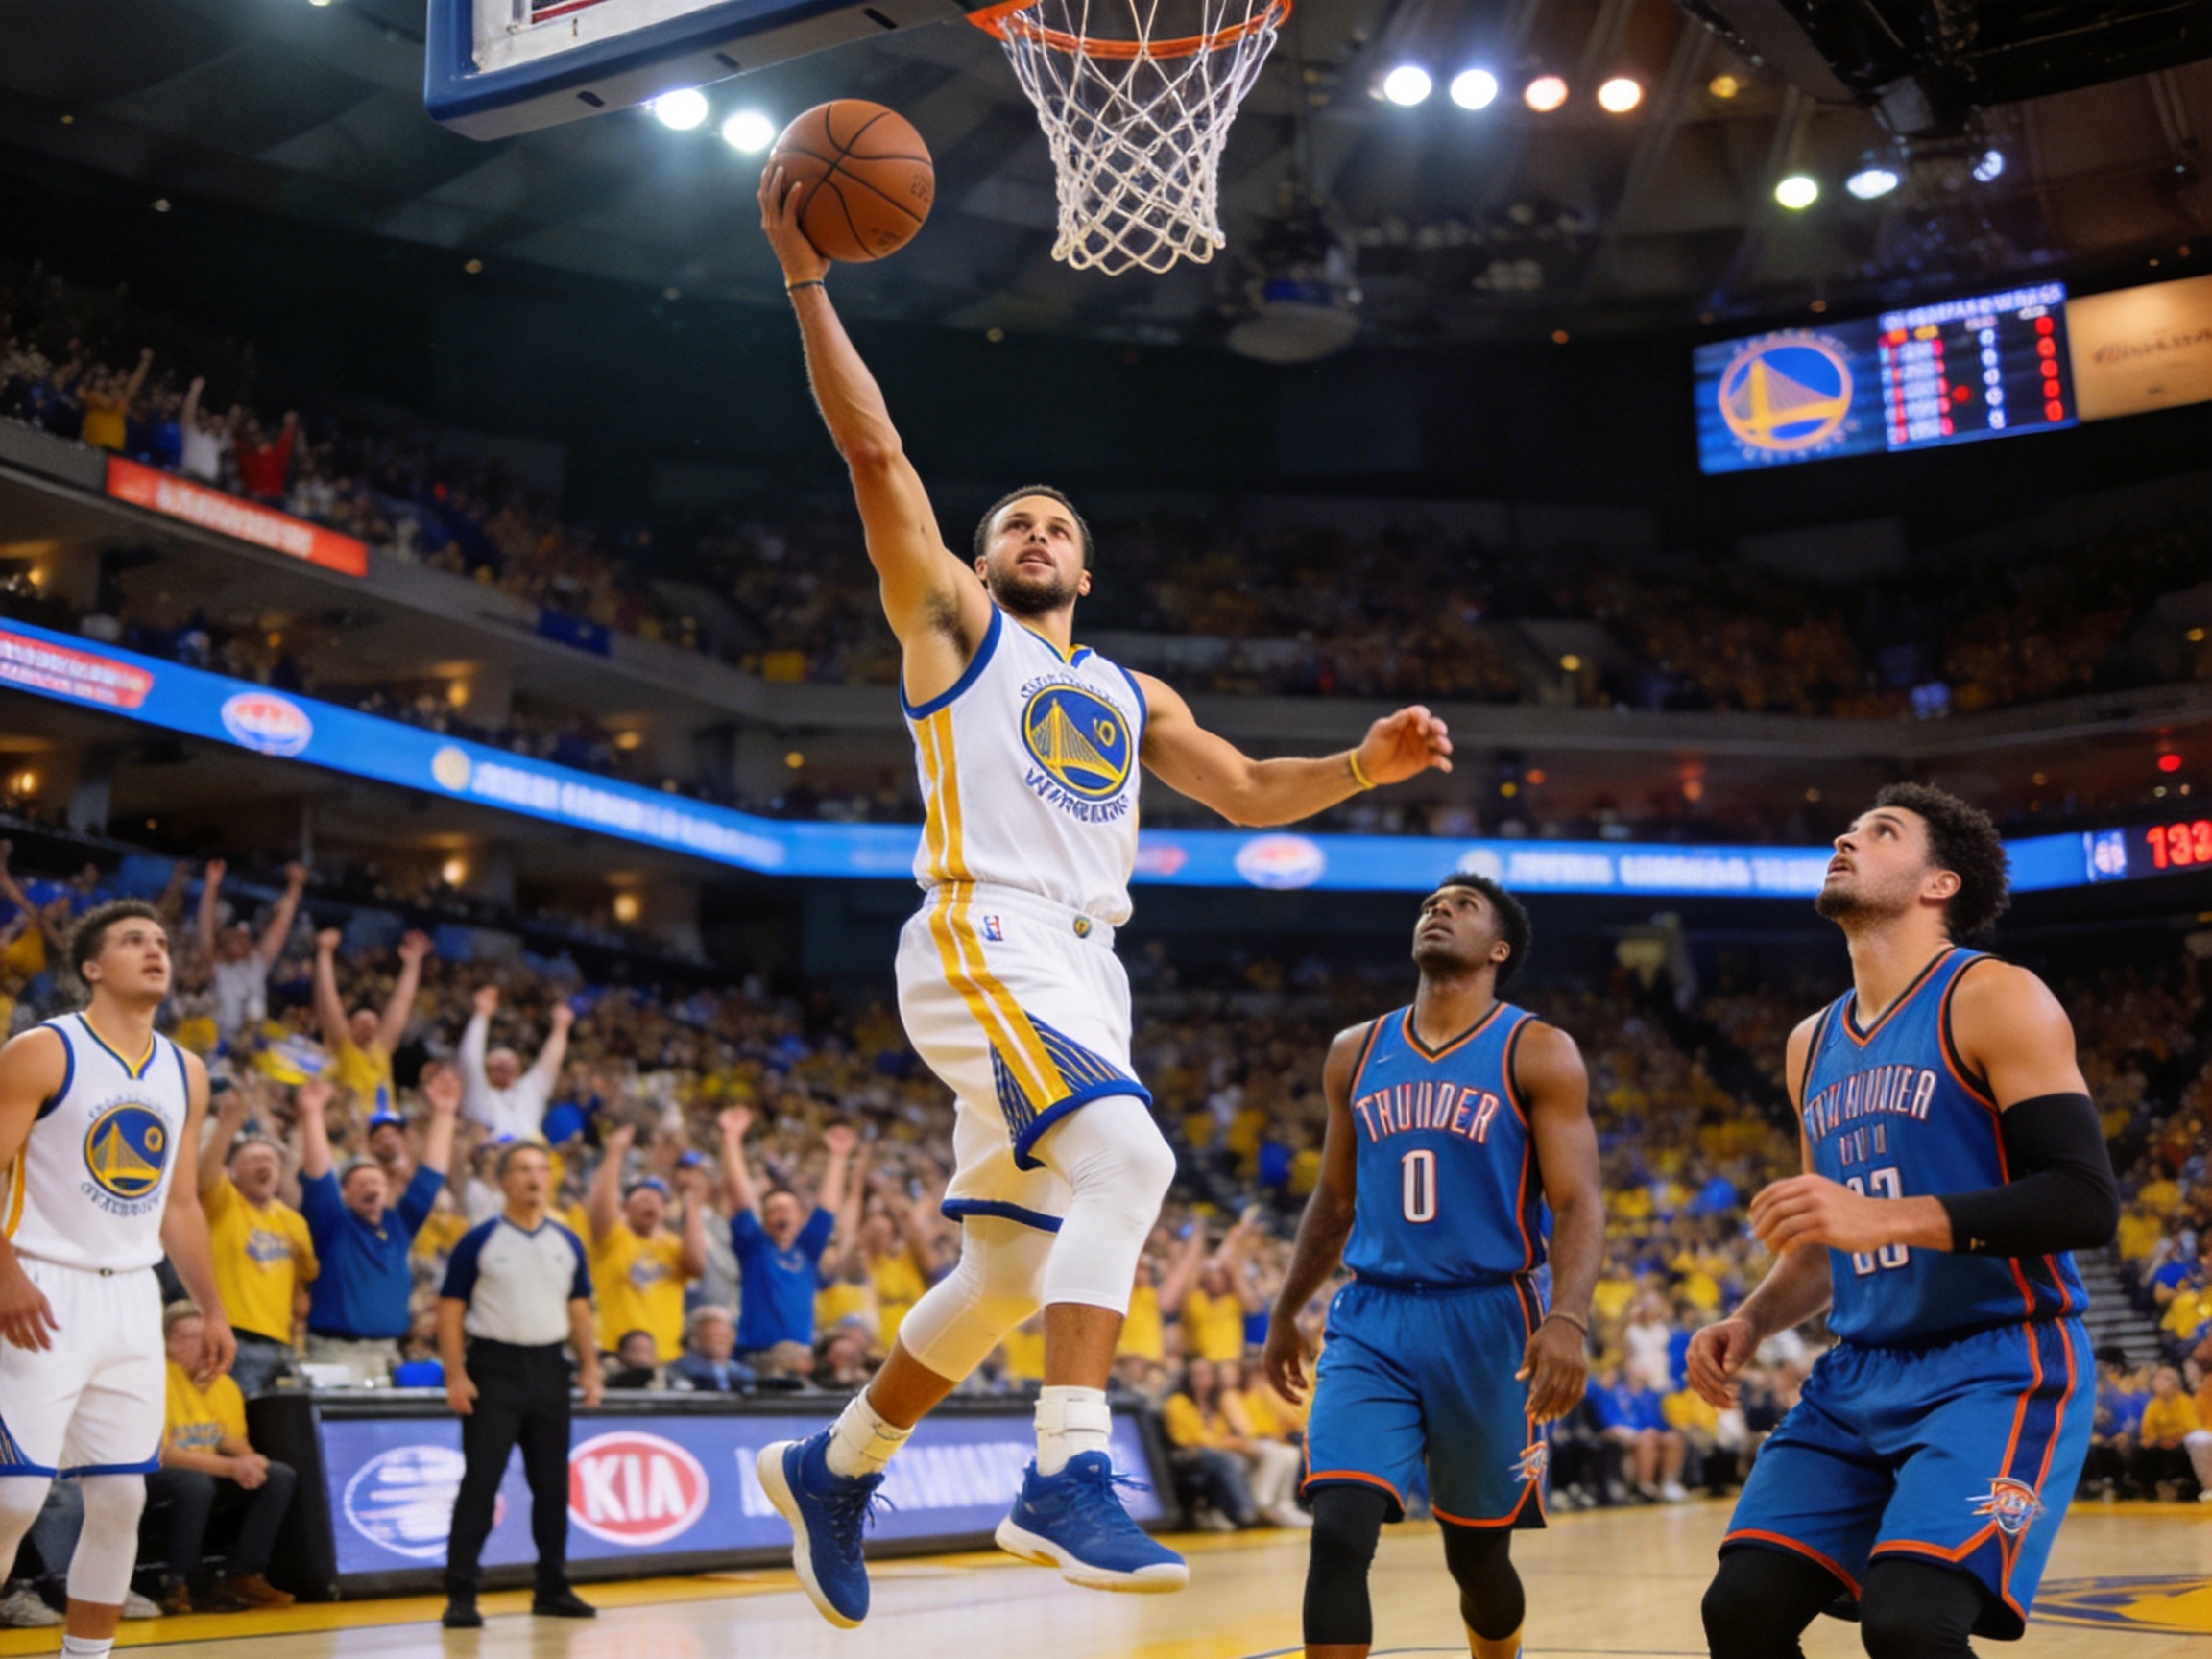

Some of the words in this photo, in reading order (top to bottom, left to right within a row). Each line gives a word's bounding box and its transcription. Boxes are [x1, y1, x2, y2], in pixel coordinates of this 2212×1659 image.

[1355, 1080, 1501, 1144] THUNDER
[1402, 1148, 1437, 1224] 0
[580, 1453, 686, 1525] KIA
